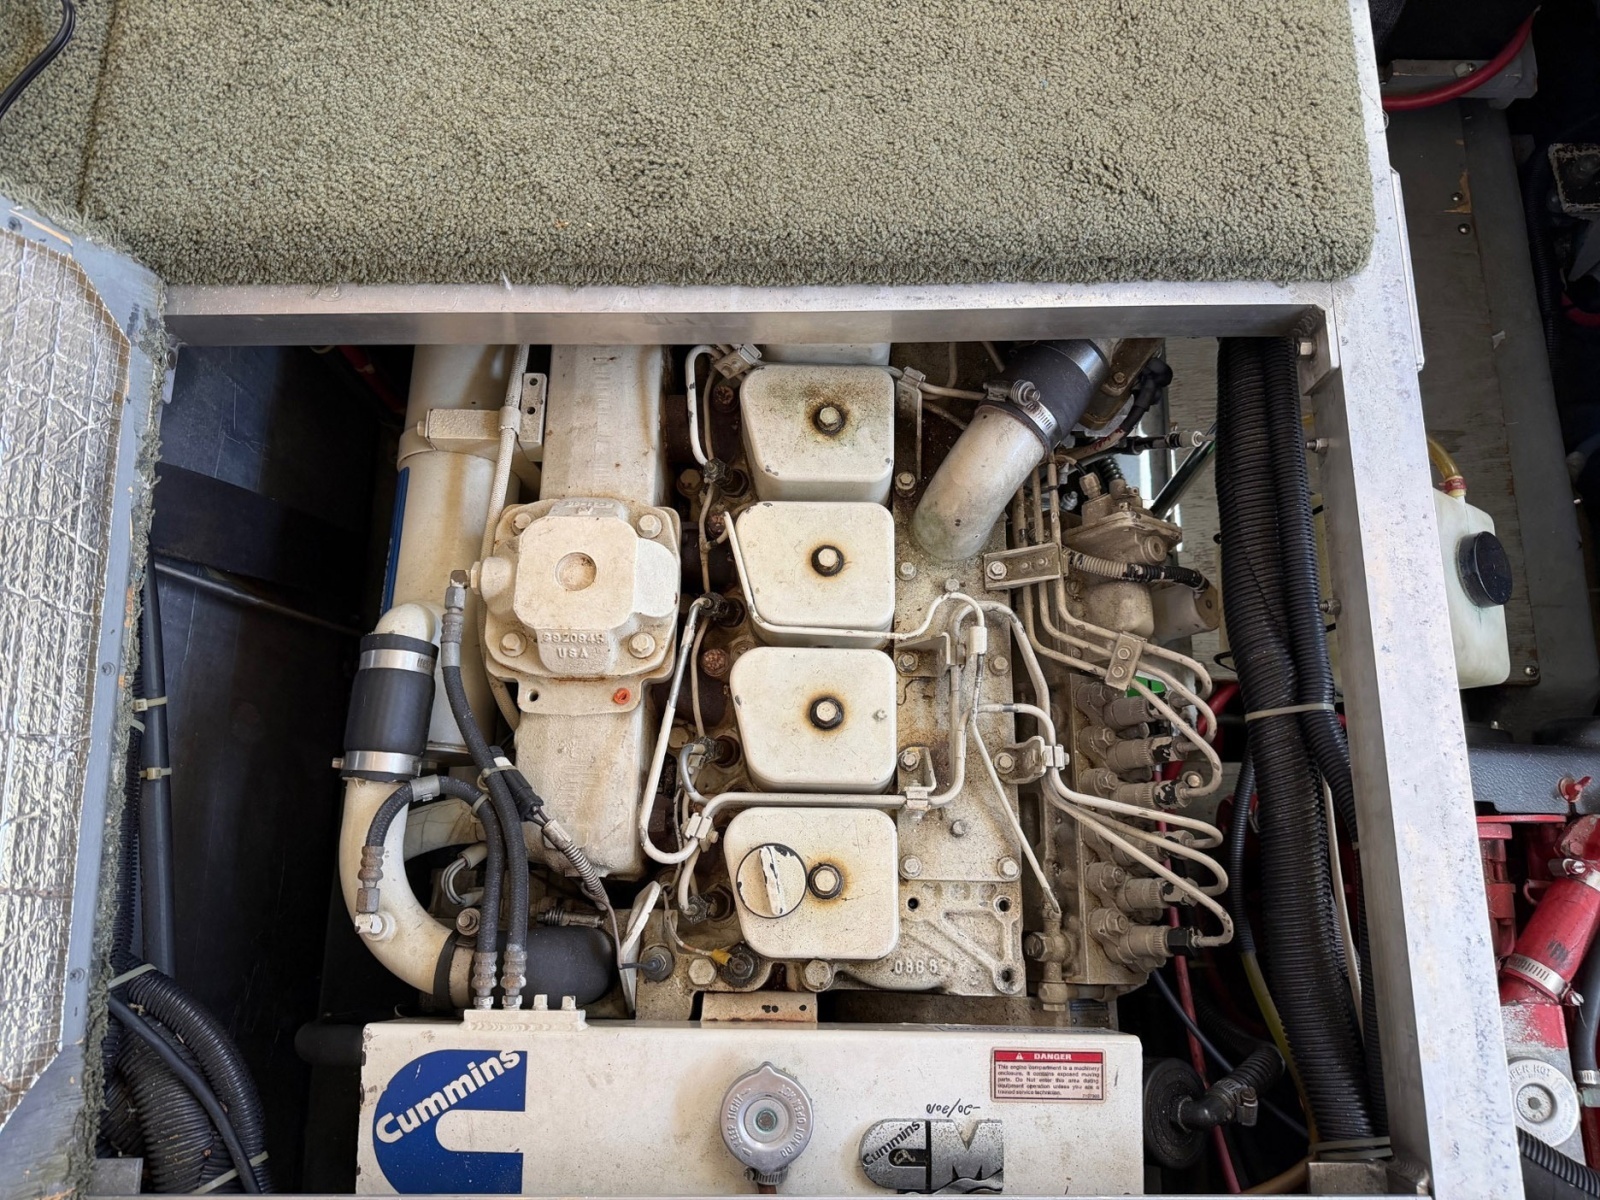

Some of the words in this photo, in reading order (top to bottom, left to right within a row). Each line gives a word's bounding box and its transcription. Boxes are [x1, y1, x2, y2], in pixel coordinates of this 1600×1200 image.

[556, 647, 590, 660] USA
[375, 1050, 521, 1144] Cummins
[727, 1093, 744, 1121] TIGHT
[791, 1099, 807, 1125] OPEN
[727, 1124, 744, 1148] KEEP
[790, 1126, 806, 1148] NOT
[861, 1119, 921, 1167] Cummins
